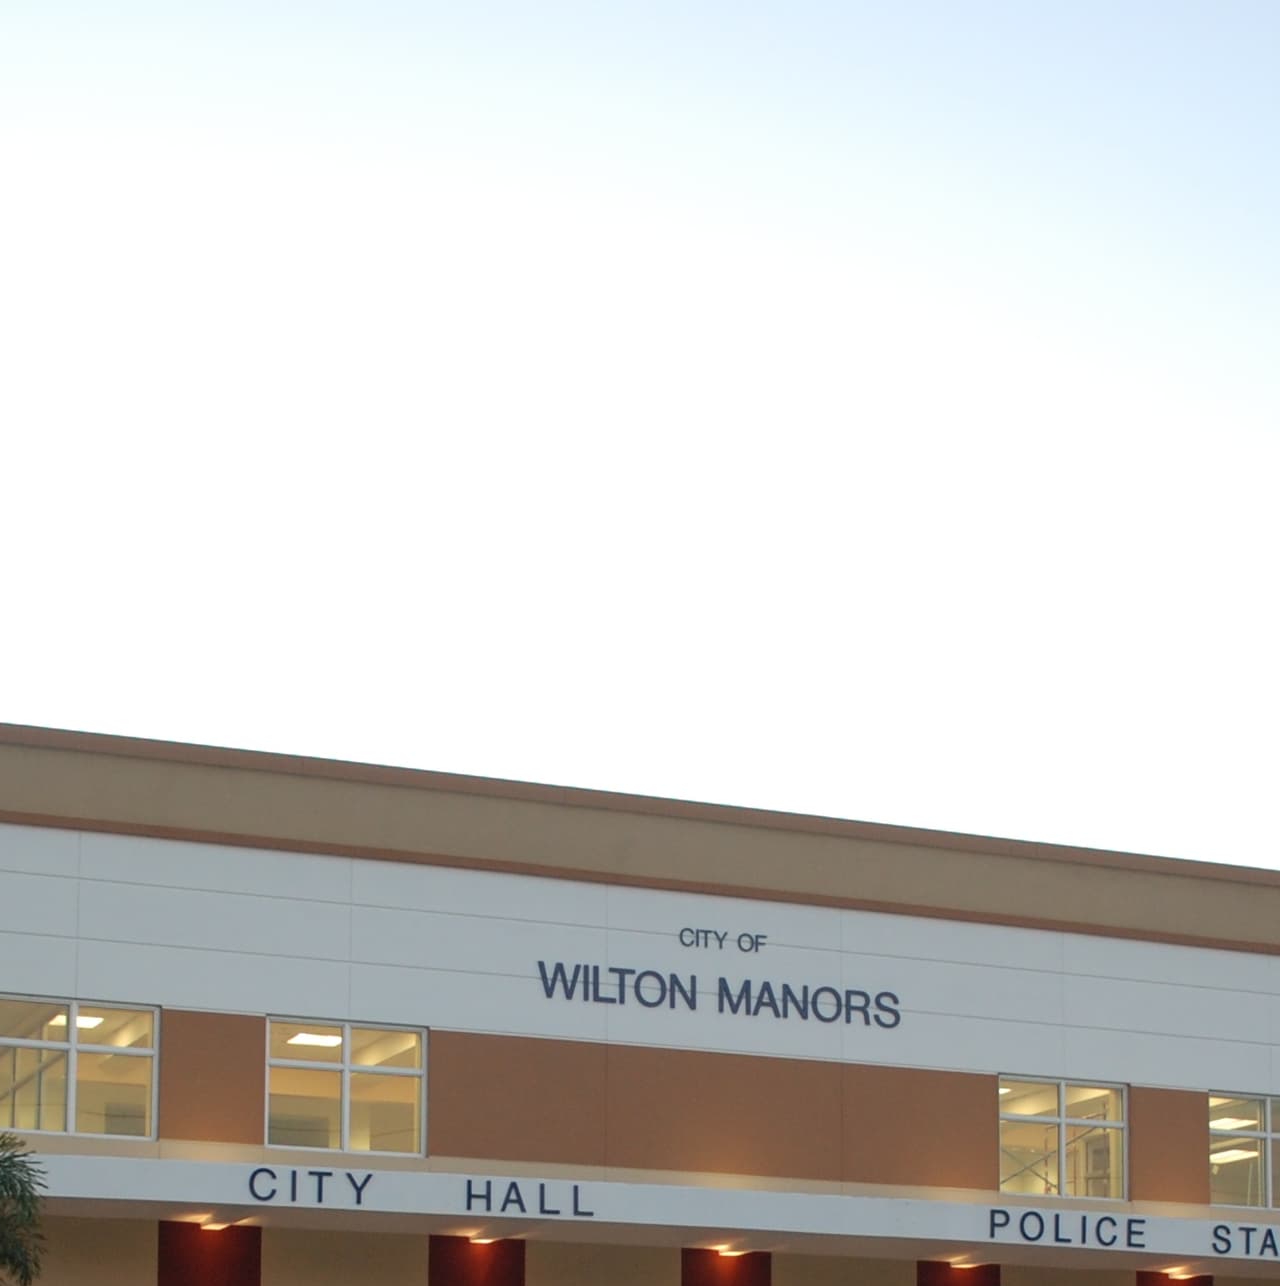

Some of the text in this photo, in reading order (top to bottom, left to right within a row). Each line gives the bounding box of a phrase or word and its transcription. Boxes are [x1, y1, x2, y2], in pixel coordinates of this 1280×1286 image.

[678, 927, 769, 954] CITY OF
[539, 960, 902, 1030] WILTON MANORS
[248, 1167, 595, 1217] CITY HALL
[989, 1208, 1147, 1249] POLICE
